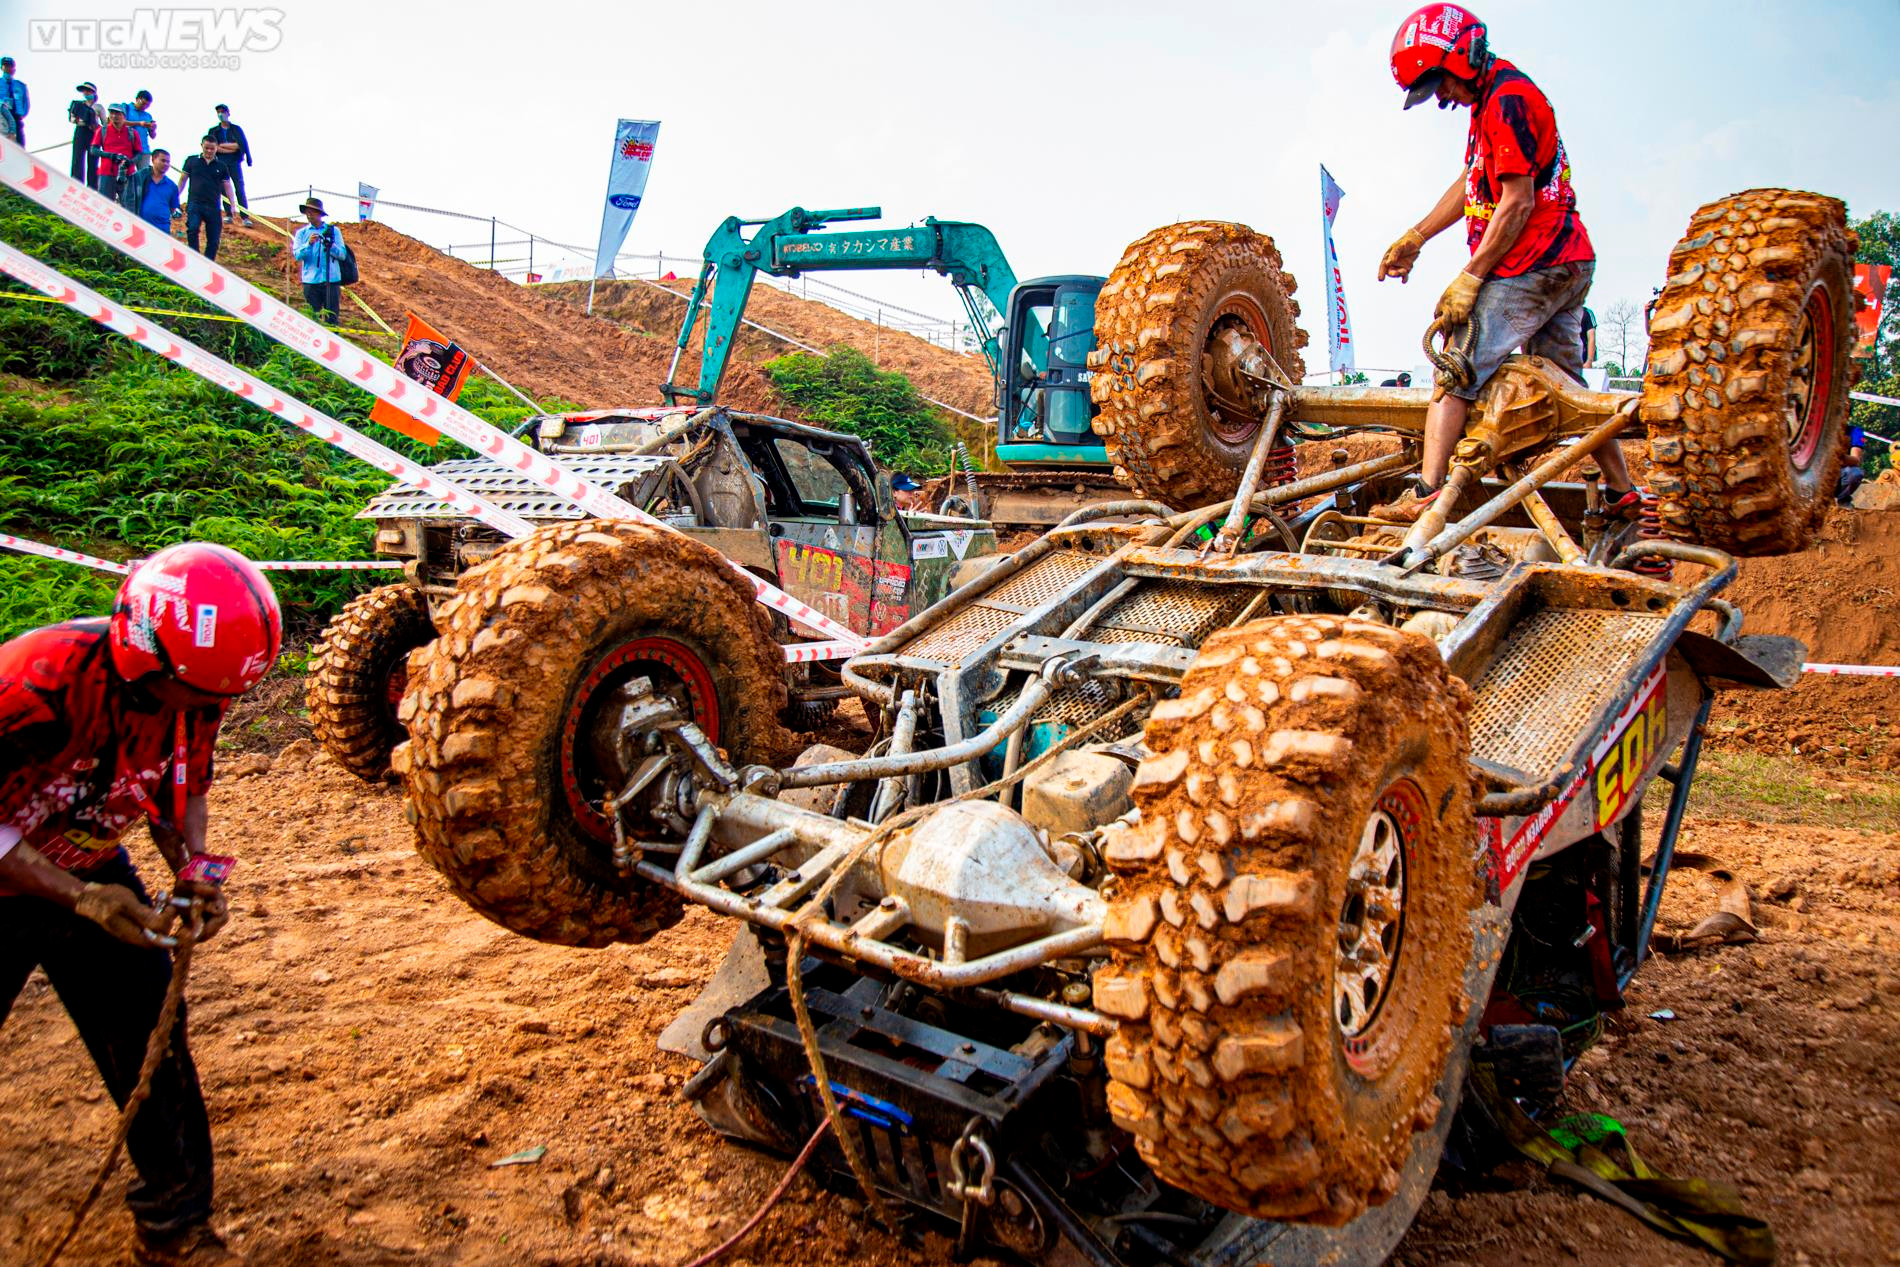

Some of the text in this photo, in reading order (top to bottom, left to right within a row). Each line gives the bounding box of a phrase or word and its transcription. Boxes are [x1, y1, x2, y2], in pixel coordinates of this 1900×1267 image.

[614, 196, 641, 208] Ford
[1333, 267, 1350, 349] PVOIL
[444, 350, 465, 375] CLUB
[583, 434, 599, 446] 401
[789, 546, 844, 591] 401
[1597, 694, 1667, 826] 403
